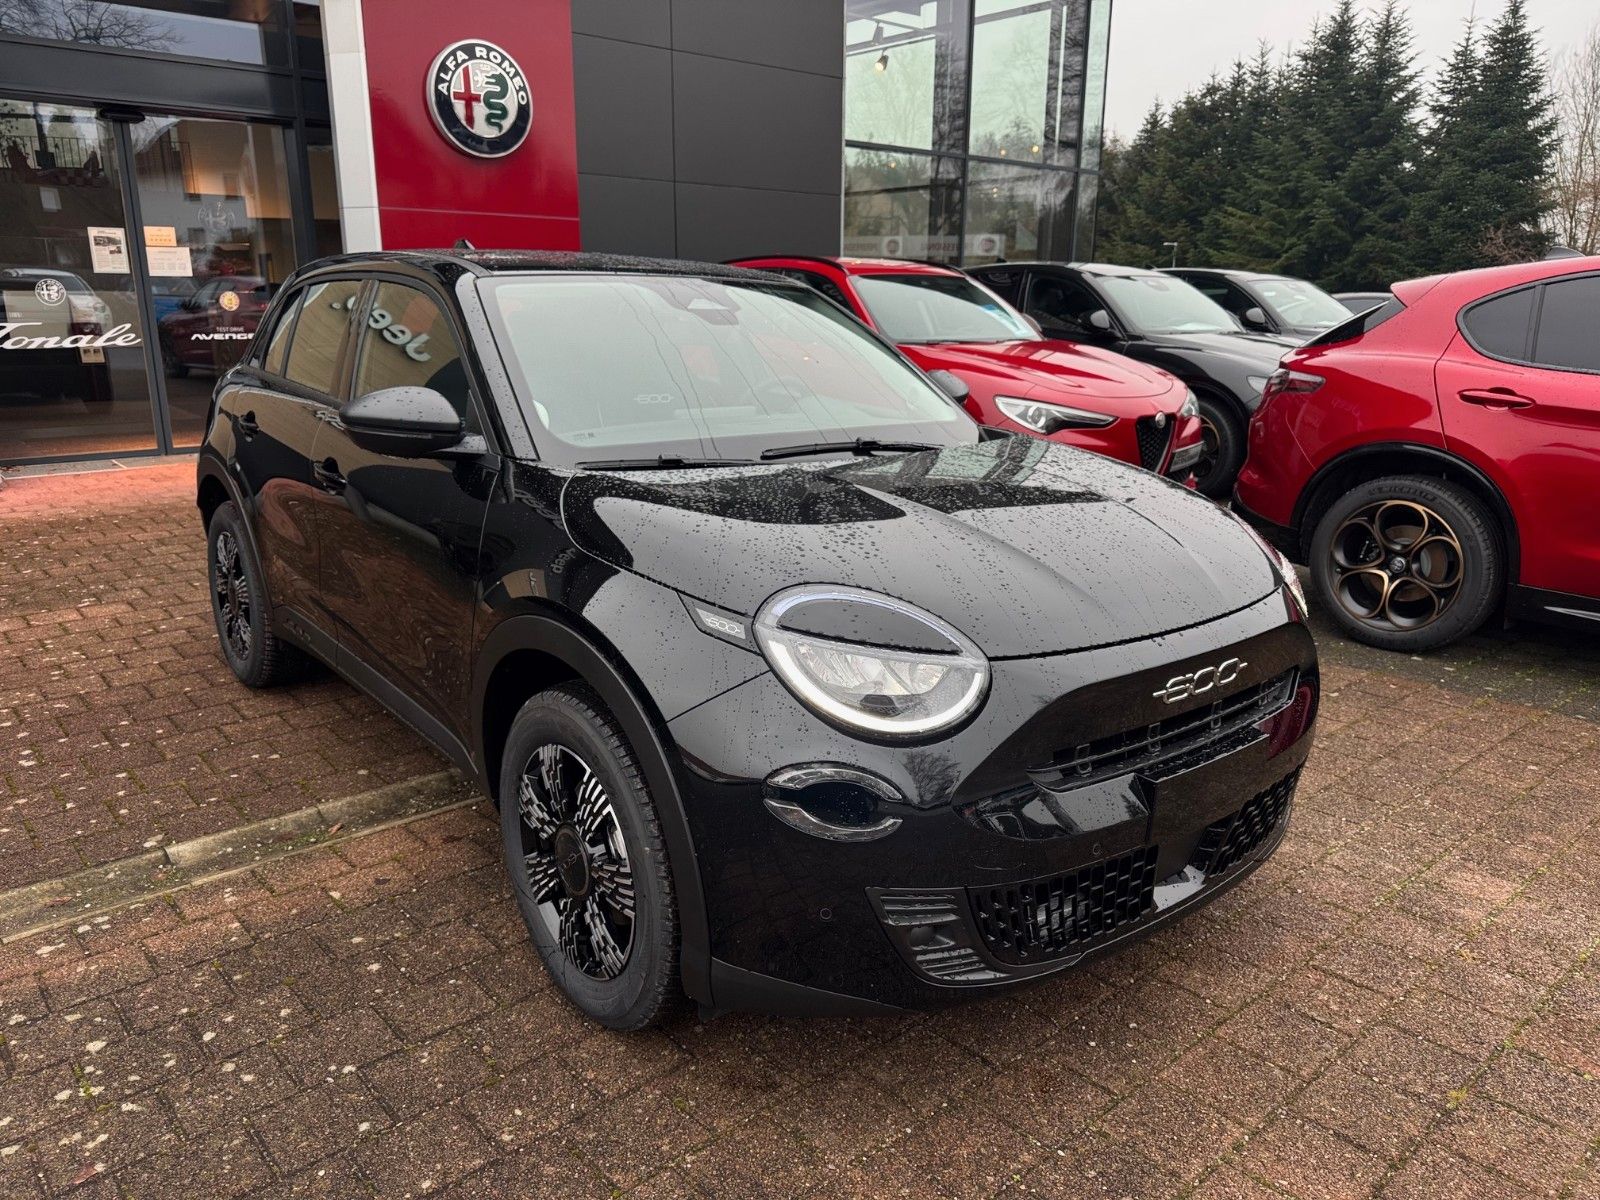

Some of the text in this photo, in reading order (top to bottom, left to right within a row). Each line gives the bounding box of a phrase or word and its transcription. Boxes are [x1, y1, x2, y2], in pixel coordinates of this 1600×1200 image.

[438, 46, 528, 105] ALFA ROMEO
[706, 618, 741, 634] 600
[1152, 658, 1248, 704] 600
